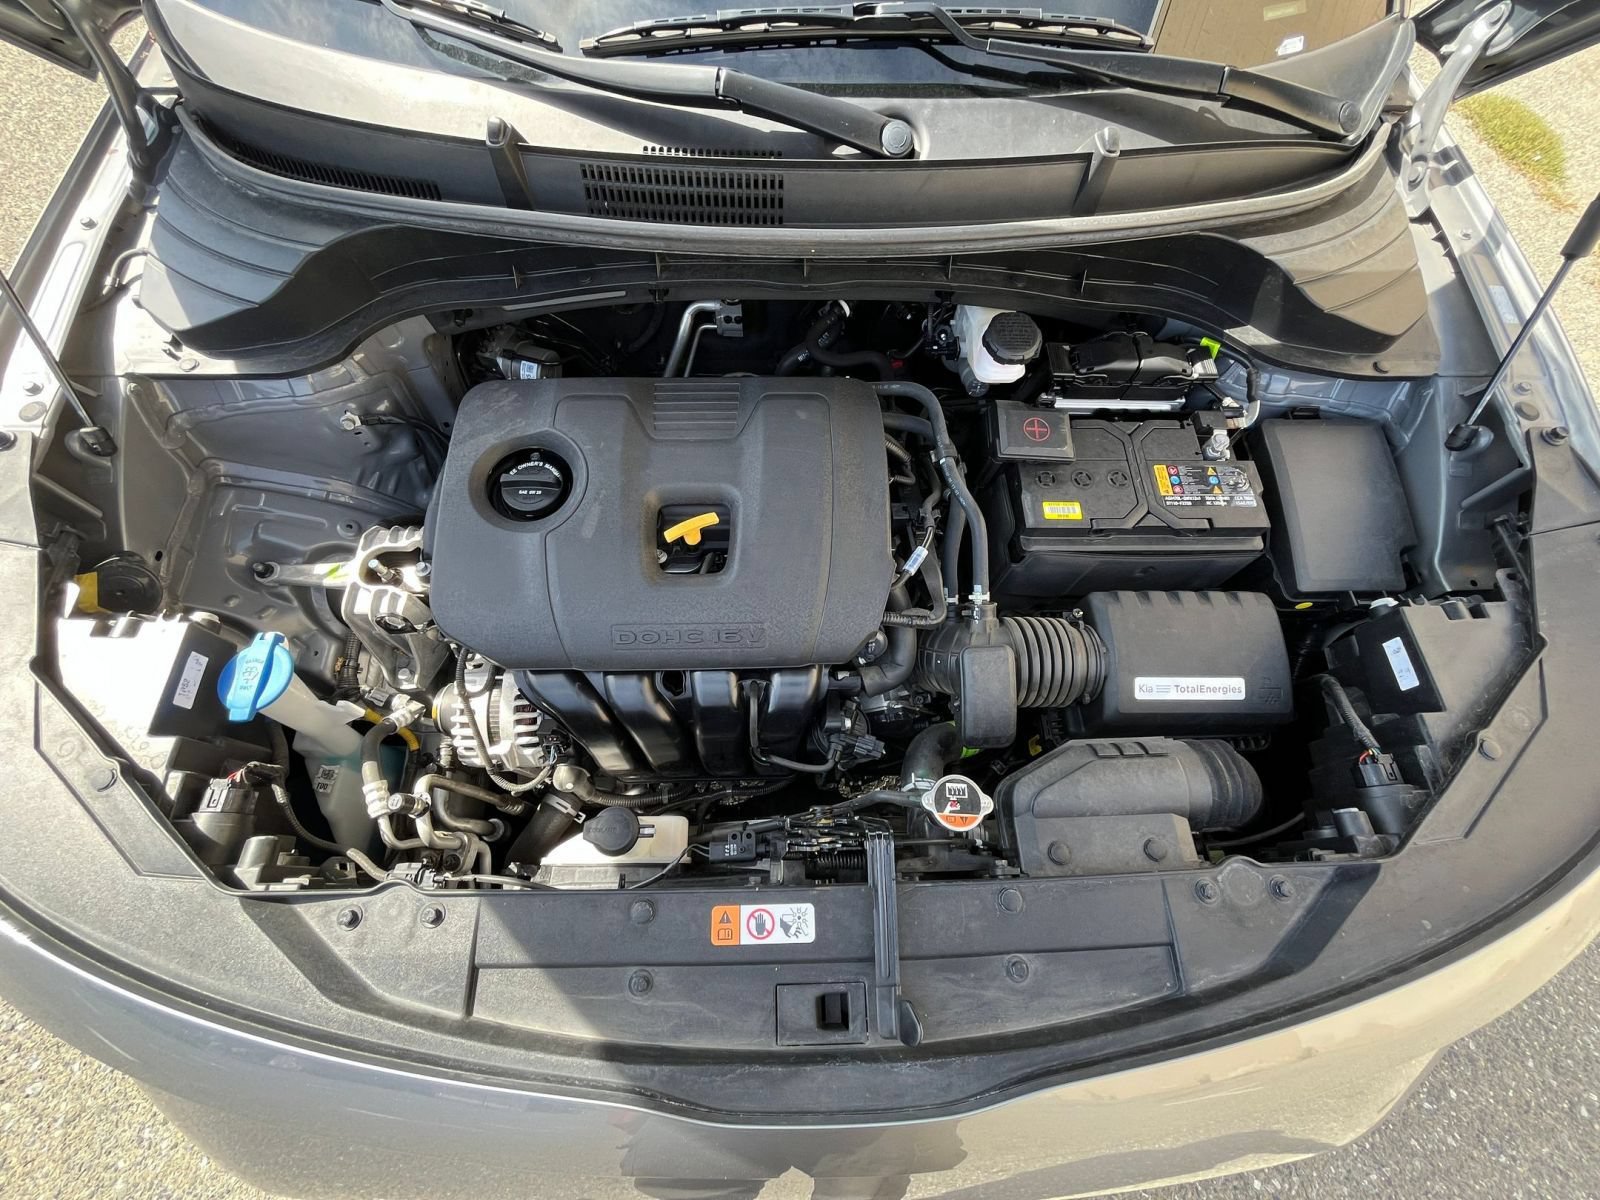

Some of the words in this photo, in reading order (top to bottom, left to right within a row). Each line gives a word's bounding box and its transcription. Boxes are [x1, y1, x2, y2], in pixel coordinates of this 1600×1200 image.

[518, 461, 544, 470] OWNER'S
[615, 629, 704, 645] DOHC
[712, 628, 765, 644] 16V
[1138, 684, 1154, 693] Kia
[1174, 684, 1242, 694] TotalEnergies
